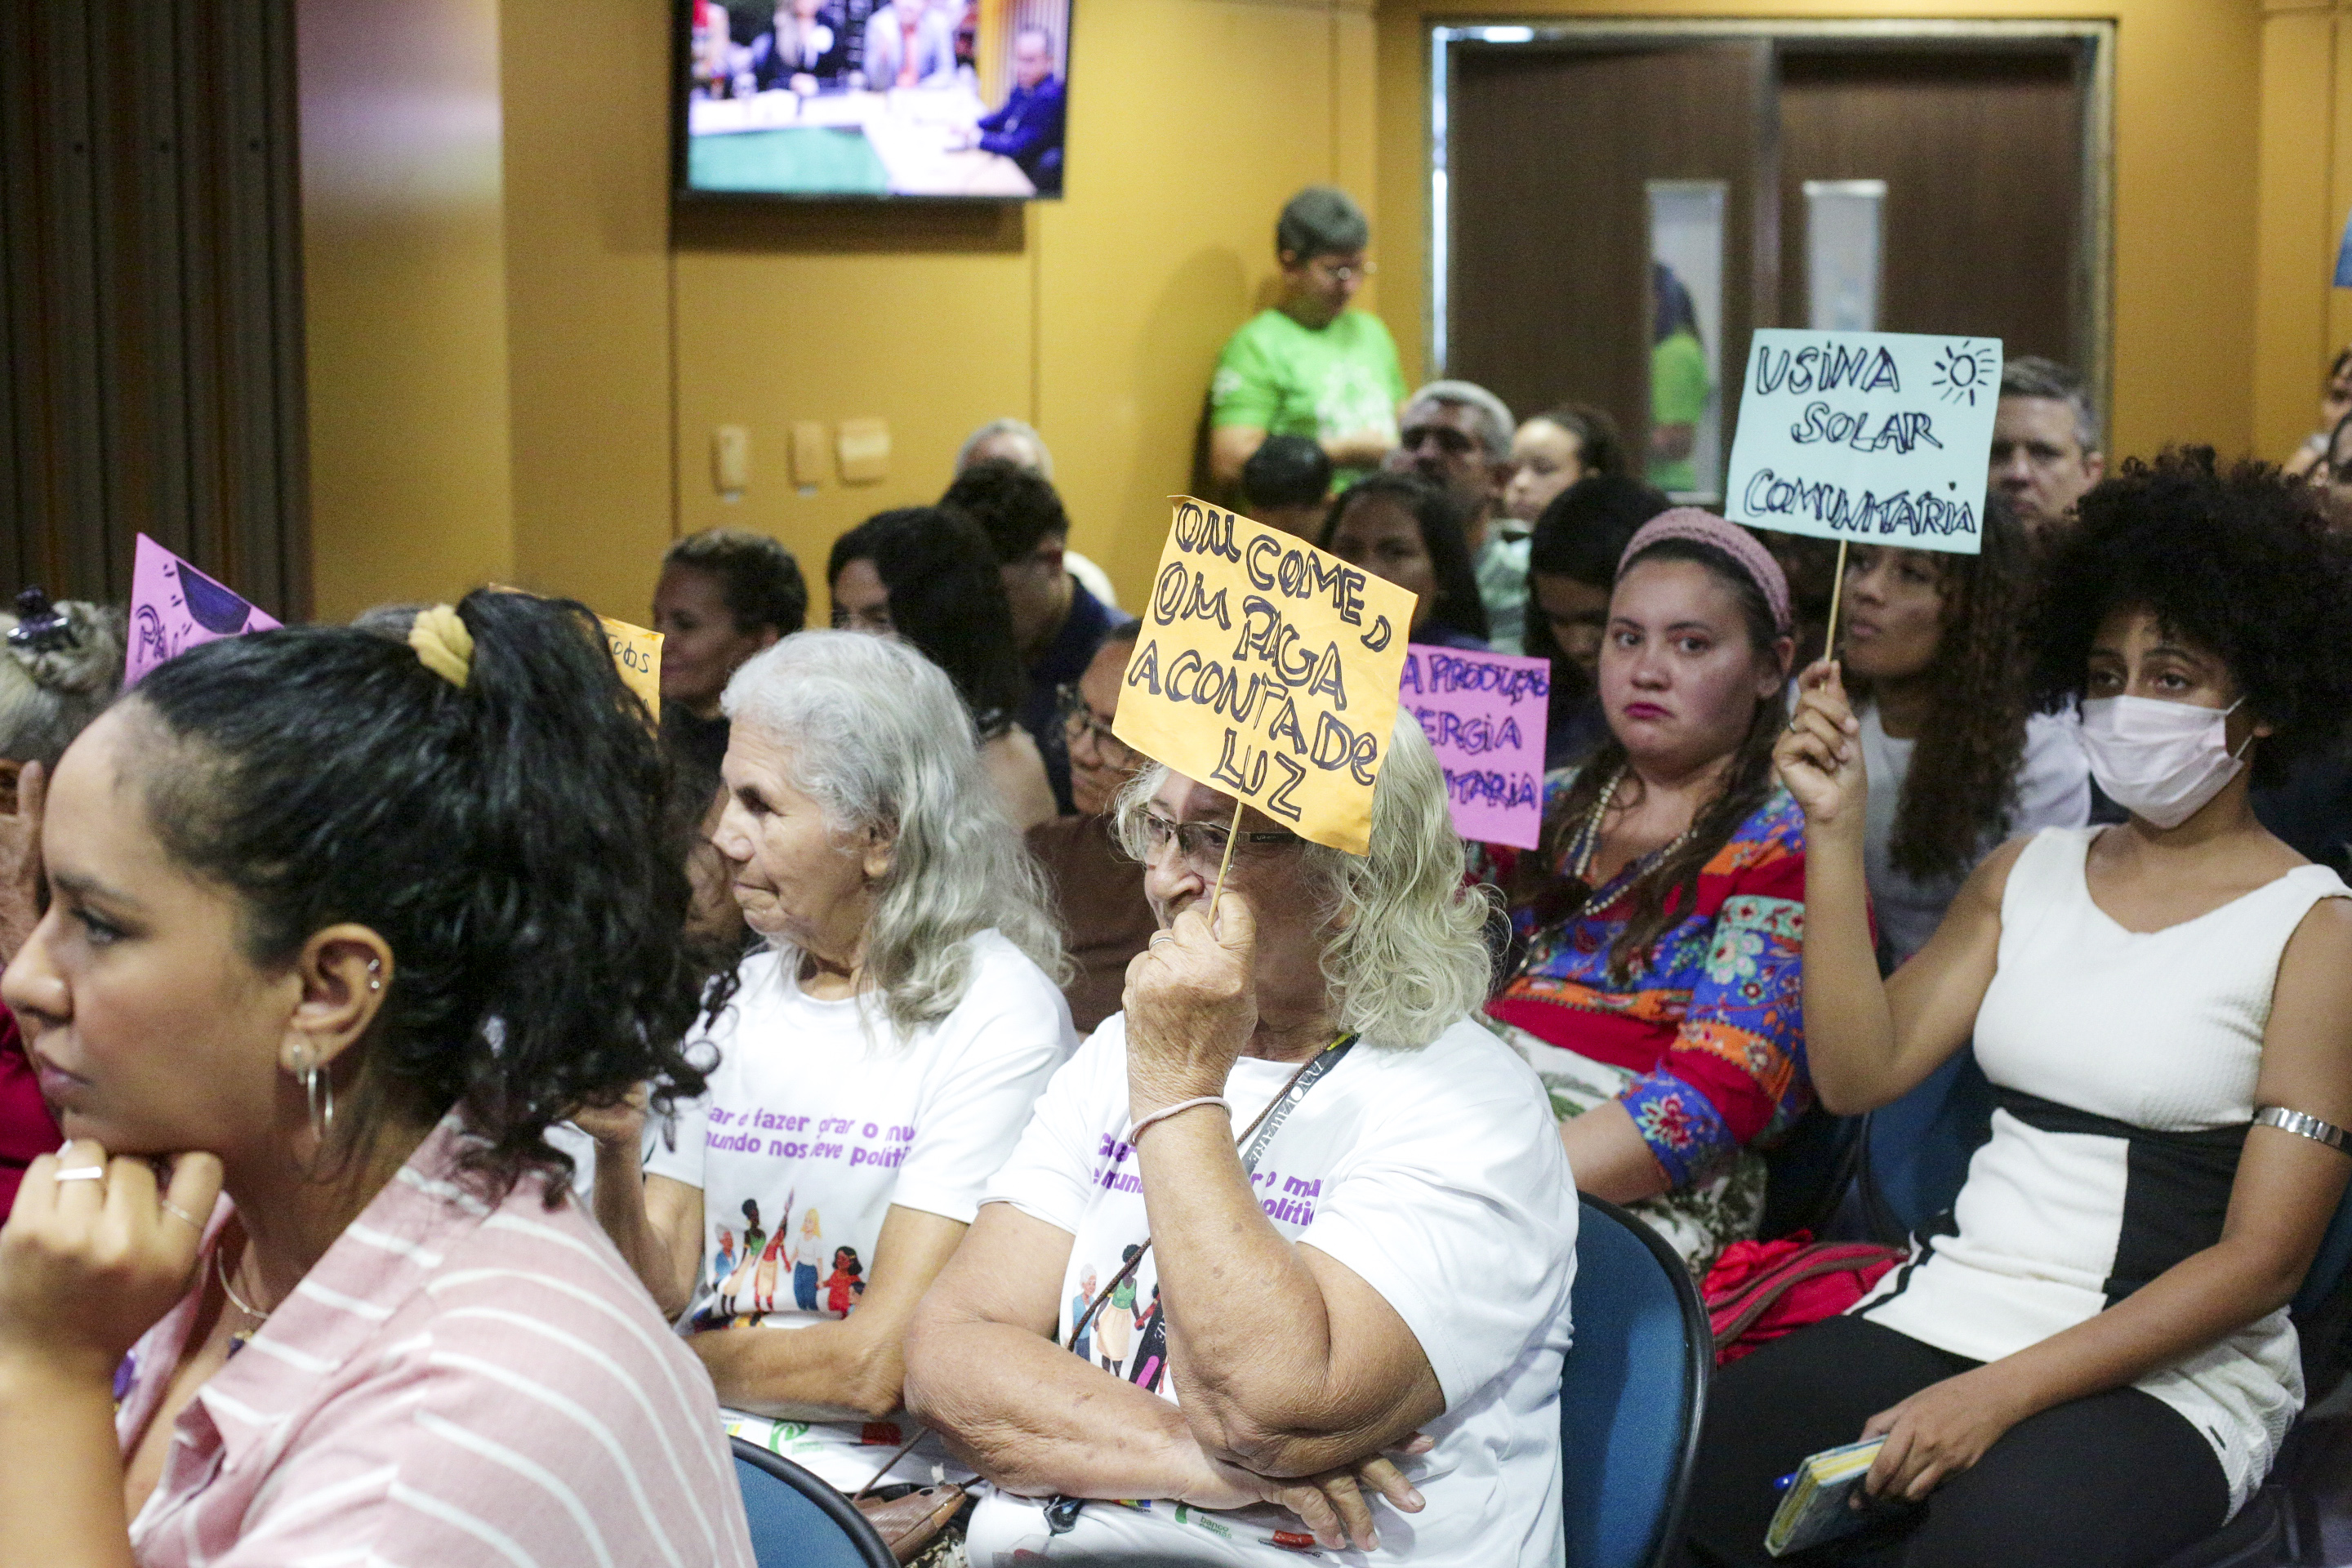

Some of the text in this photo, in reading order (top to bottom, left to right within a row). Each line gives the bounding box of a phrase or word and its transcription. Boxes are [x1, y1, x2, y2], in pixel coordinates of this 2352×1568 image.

[1790, 401, 1944, 454] SOLAR
[1234, 595, 1348, 711] PAGA
[1210, 728, 1307, 822] LUZ
[768, 1140, 808, 1159] nos
